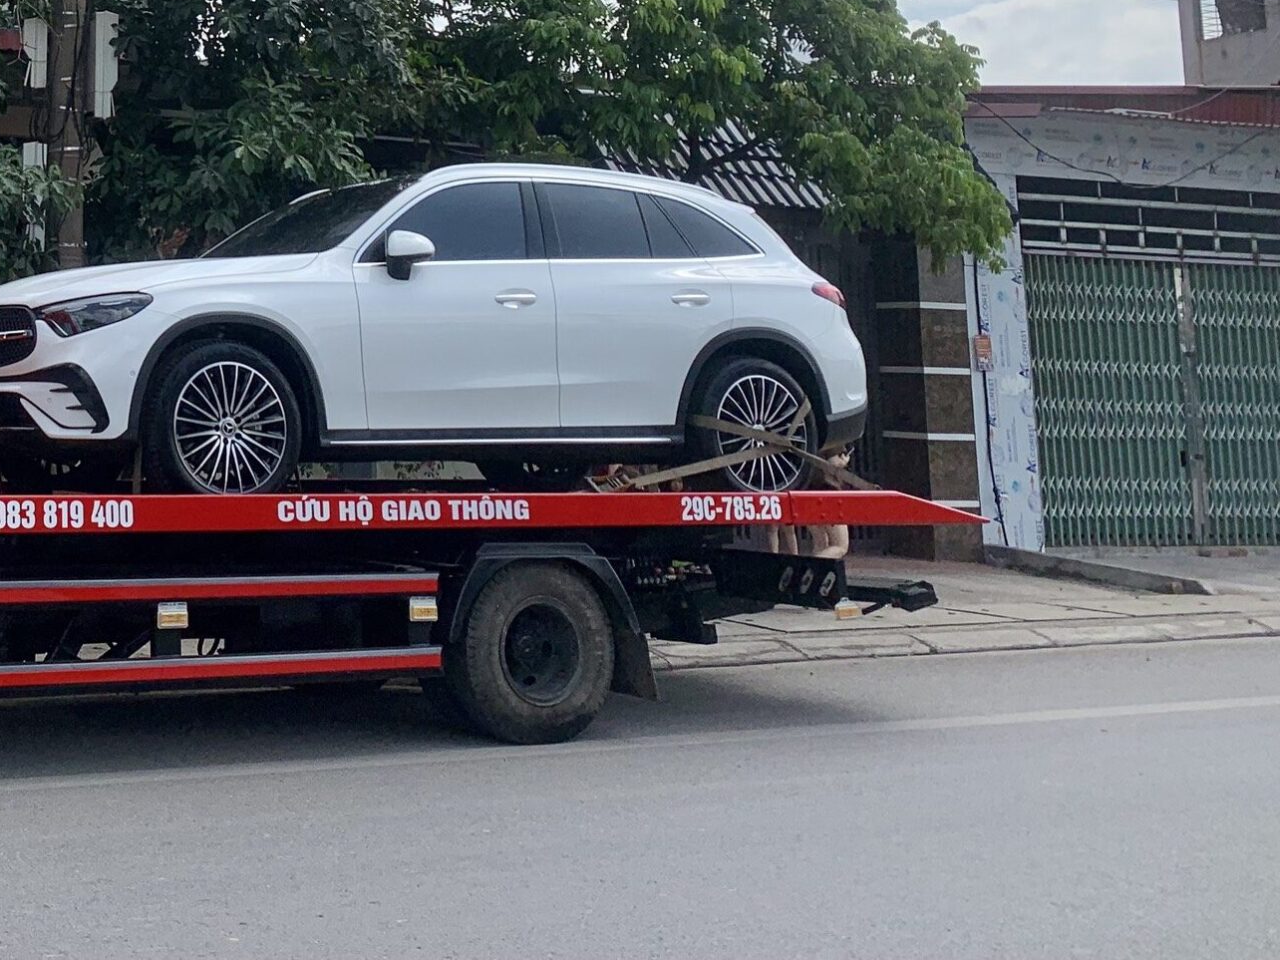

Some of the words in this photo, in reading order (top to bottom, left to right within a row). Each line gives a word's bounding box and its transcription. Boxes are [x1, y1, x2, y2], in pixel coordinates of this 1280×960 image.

[43, 499, 85, 529] 819
[90, 499, 135, 528] 400
[277, 494, 331, 523] CỨU
[339, 495, 374, 526] HỘ
[381, 499, 442, 522] GIAO
[448, 495, 531, 521] THÔNG
[680, 495, 783, 522] 29C-785.26
